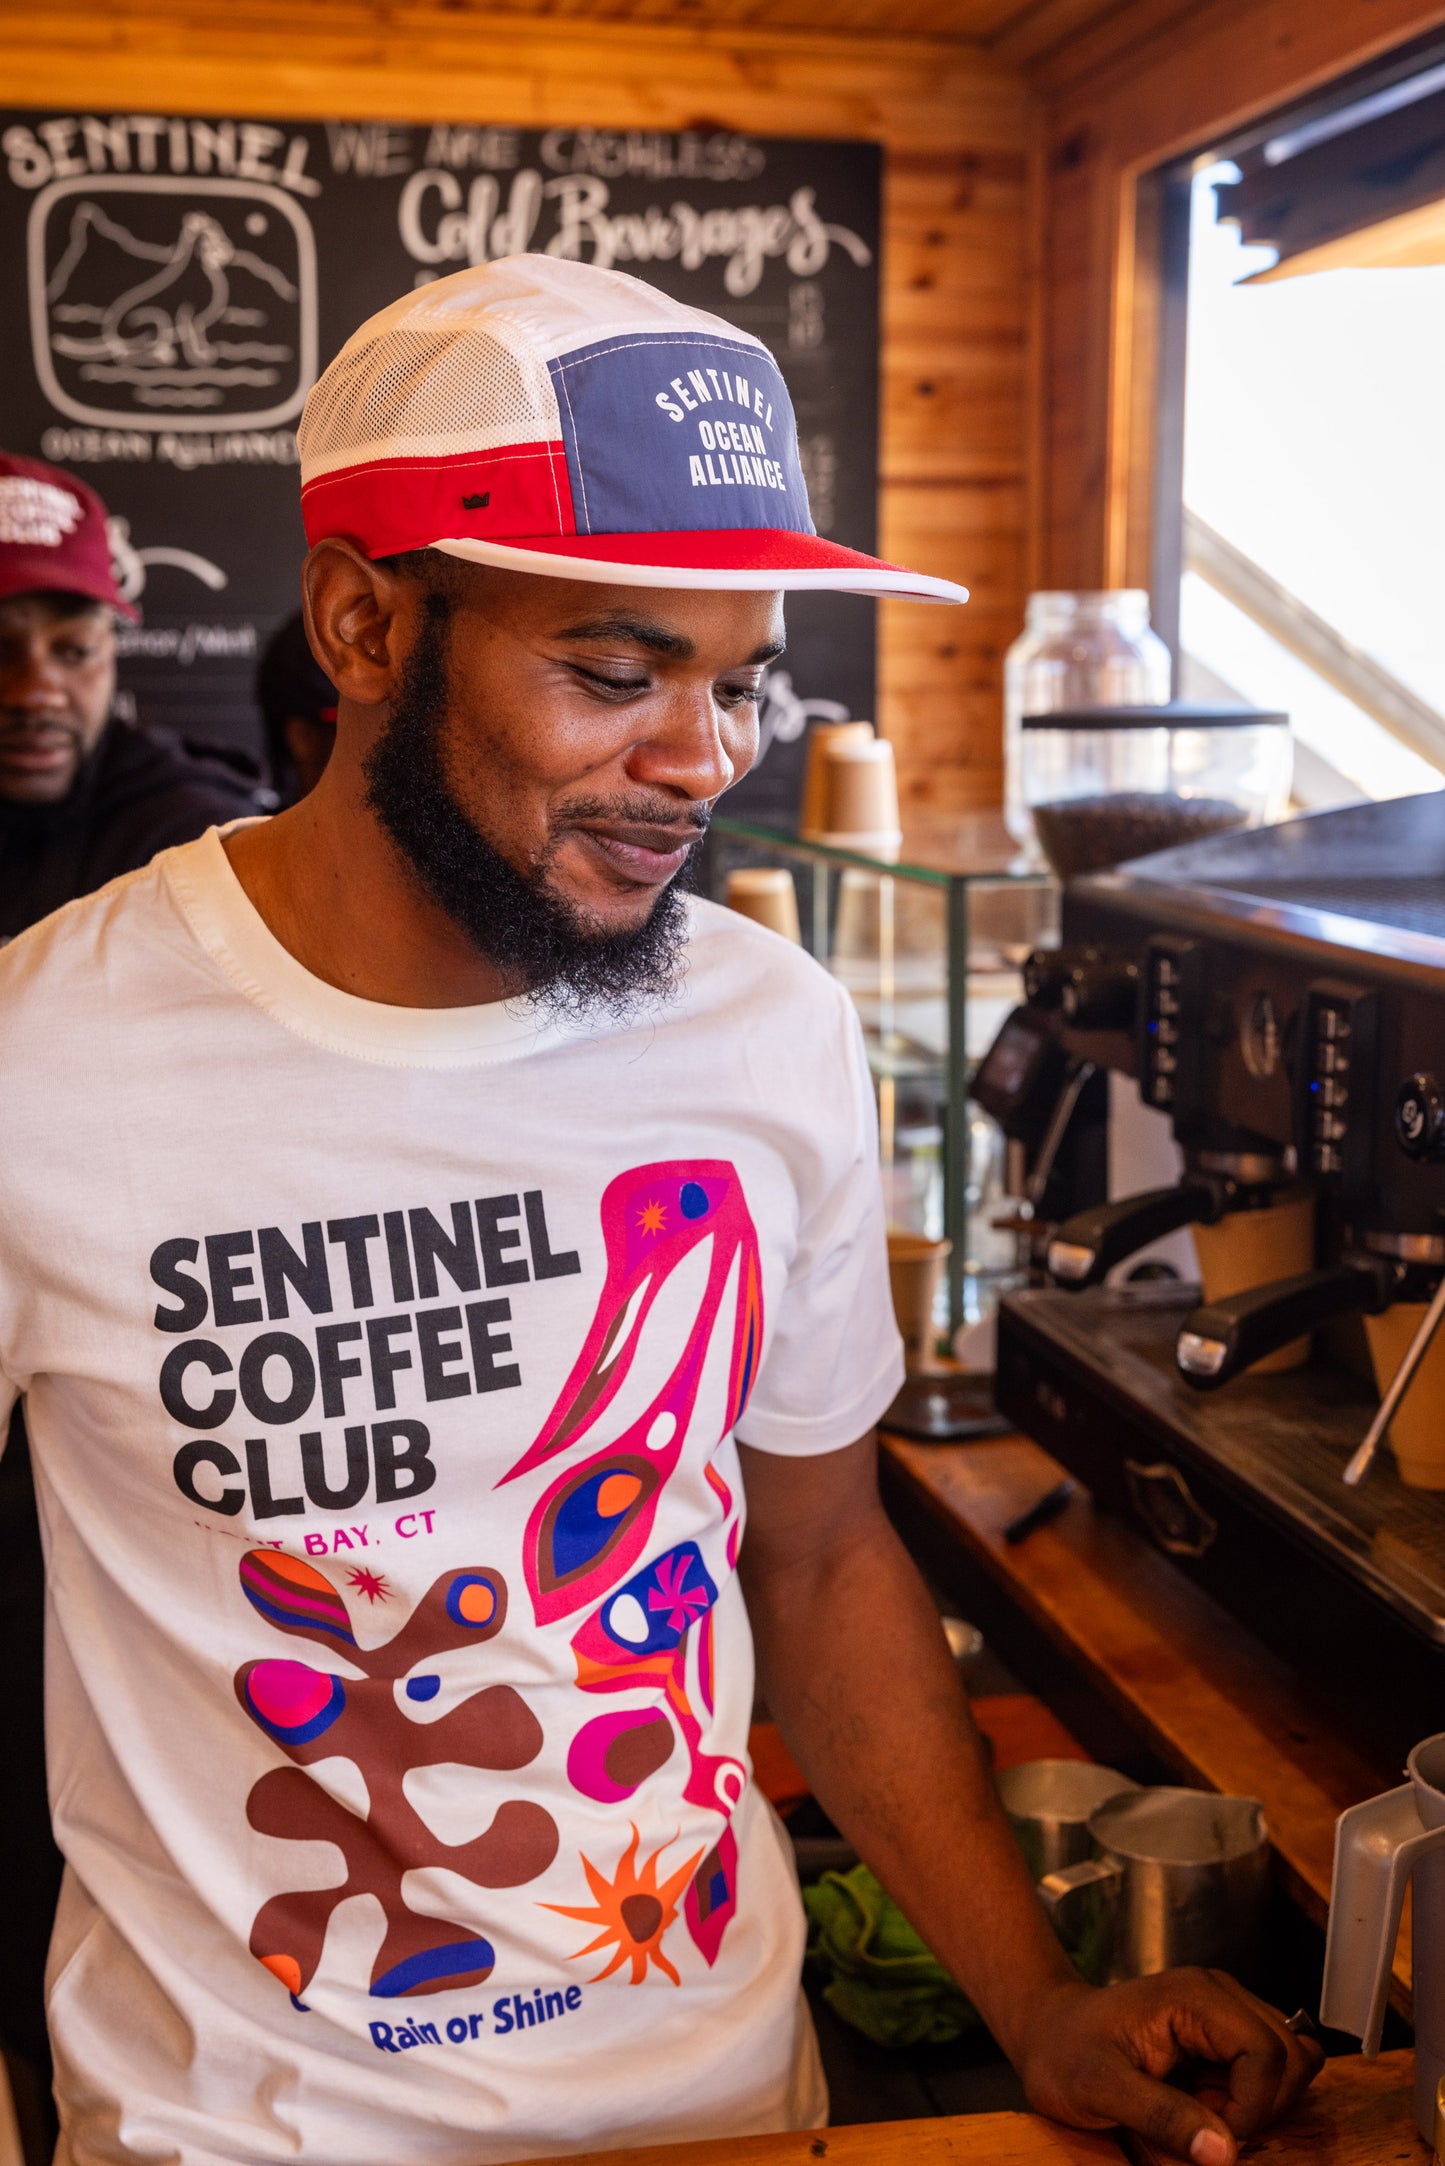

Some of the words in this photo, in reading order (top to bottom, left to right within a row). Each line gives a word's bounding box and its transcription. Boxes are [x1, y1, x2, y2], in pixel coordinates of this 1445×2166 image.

[2, 115, 322, 198] SENTINEL
[324, 119, 413, 177] WE
[422, 121, 520, 170] ARE
[539, 126, 767, 181] CASHLESS
[398, 168, 543, 268] Cold
[543, 173, 872, 297] Beverages
[655, 368, 773, 433] SENTINEL
[157, 430, 299, 471] ALLIANC
[698, 419, 767, 455] OCEAN
[689, 453, 787, 491] ALLIANCE
[149, 1189, 582, 1334] SENTINEL
[159, 1297, 523, 1430] COFFEE
[172, 1419, 437, 1521] CLUB
[304, 1524, 381, 1557] BAY,
[394, 1510, 437, 1540] CT
[368, 2017, 443, 2054] Rain
[446, 2013, 484, 2043] or
[492, 1984, 583, 2035] Shine
